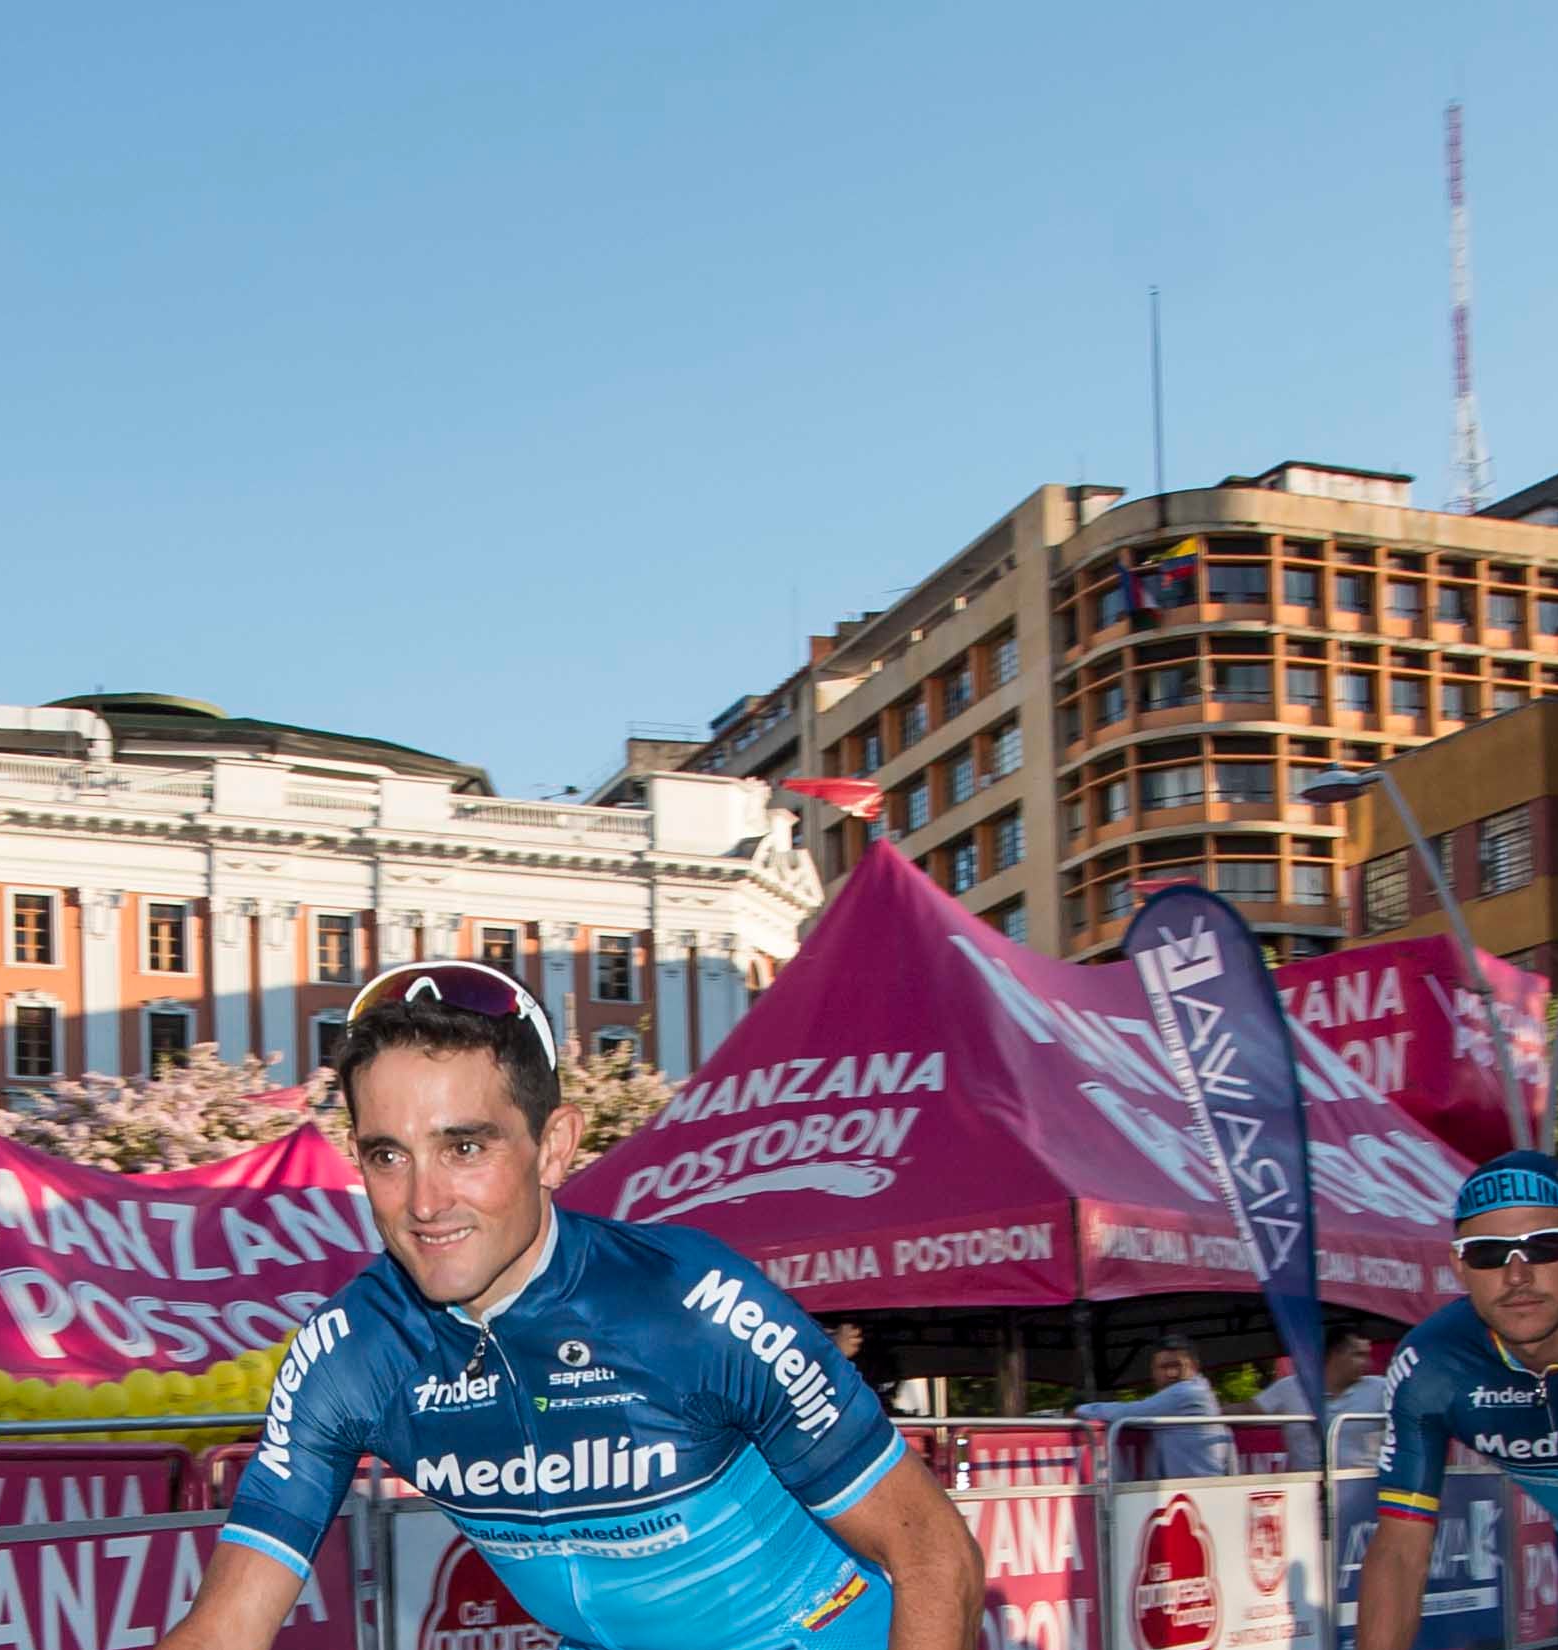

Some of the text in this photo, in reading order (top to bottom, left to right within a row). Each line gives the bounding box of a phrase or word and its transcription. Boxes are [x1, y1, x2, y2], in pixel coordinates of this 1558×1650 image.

[654, 1052, 947, 1130] MANZANA
[613, 1107, 922, 1222] POSTOBON
[894, 1222, 1054, 1277] POSTOBON
[682, 1269, 840, 1440] Medellín
[413, 1370, 501, 1412] inder
[415, 1436, 677, 1497] Medellín
[570, 1512, 682, 1542] Medellín
